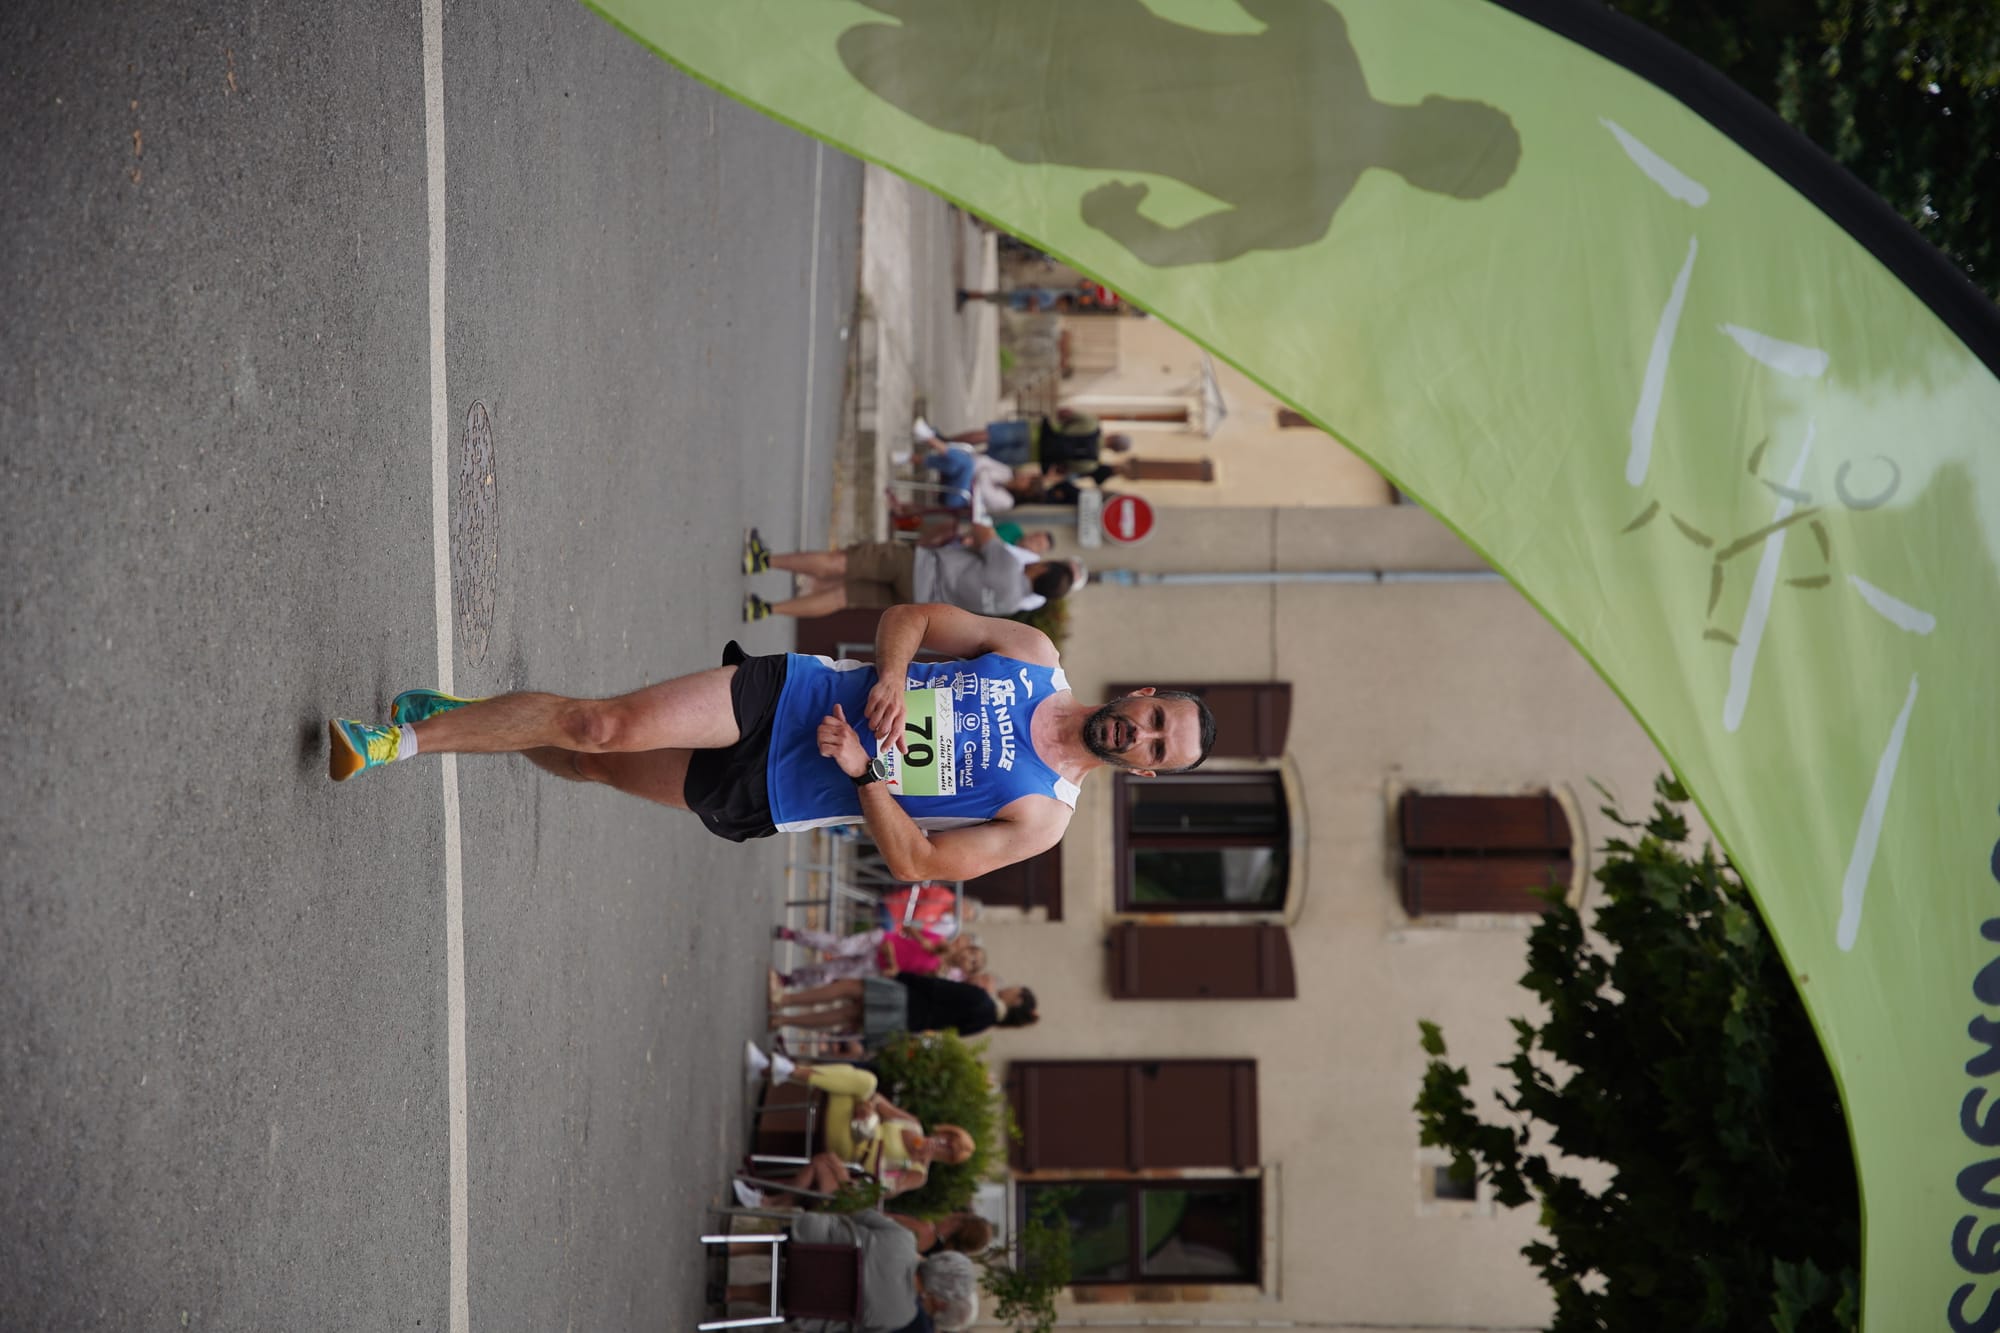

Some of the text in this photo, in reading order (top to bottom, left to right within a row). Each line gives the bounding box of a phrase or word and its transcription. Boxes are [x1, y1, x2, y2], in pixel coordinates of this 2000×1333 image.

[966, 717, 976, 727] U
[903, 716, 933, 767] 70
[945, 738, 953, 772] Challenge
